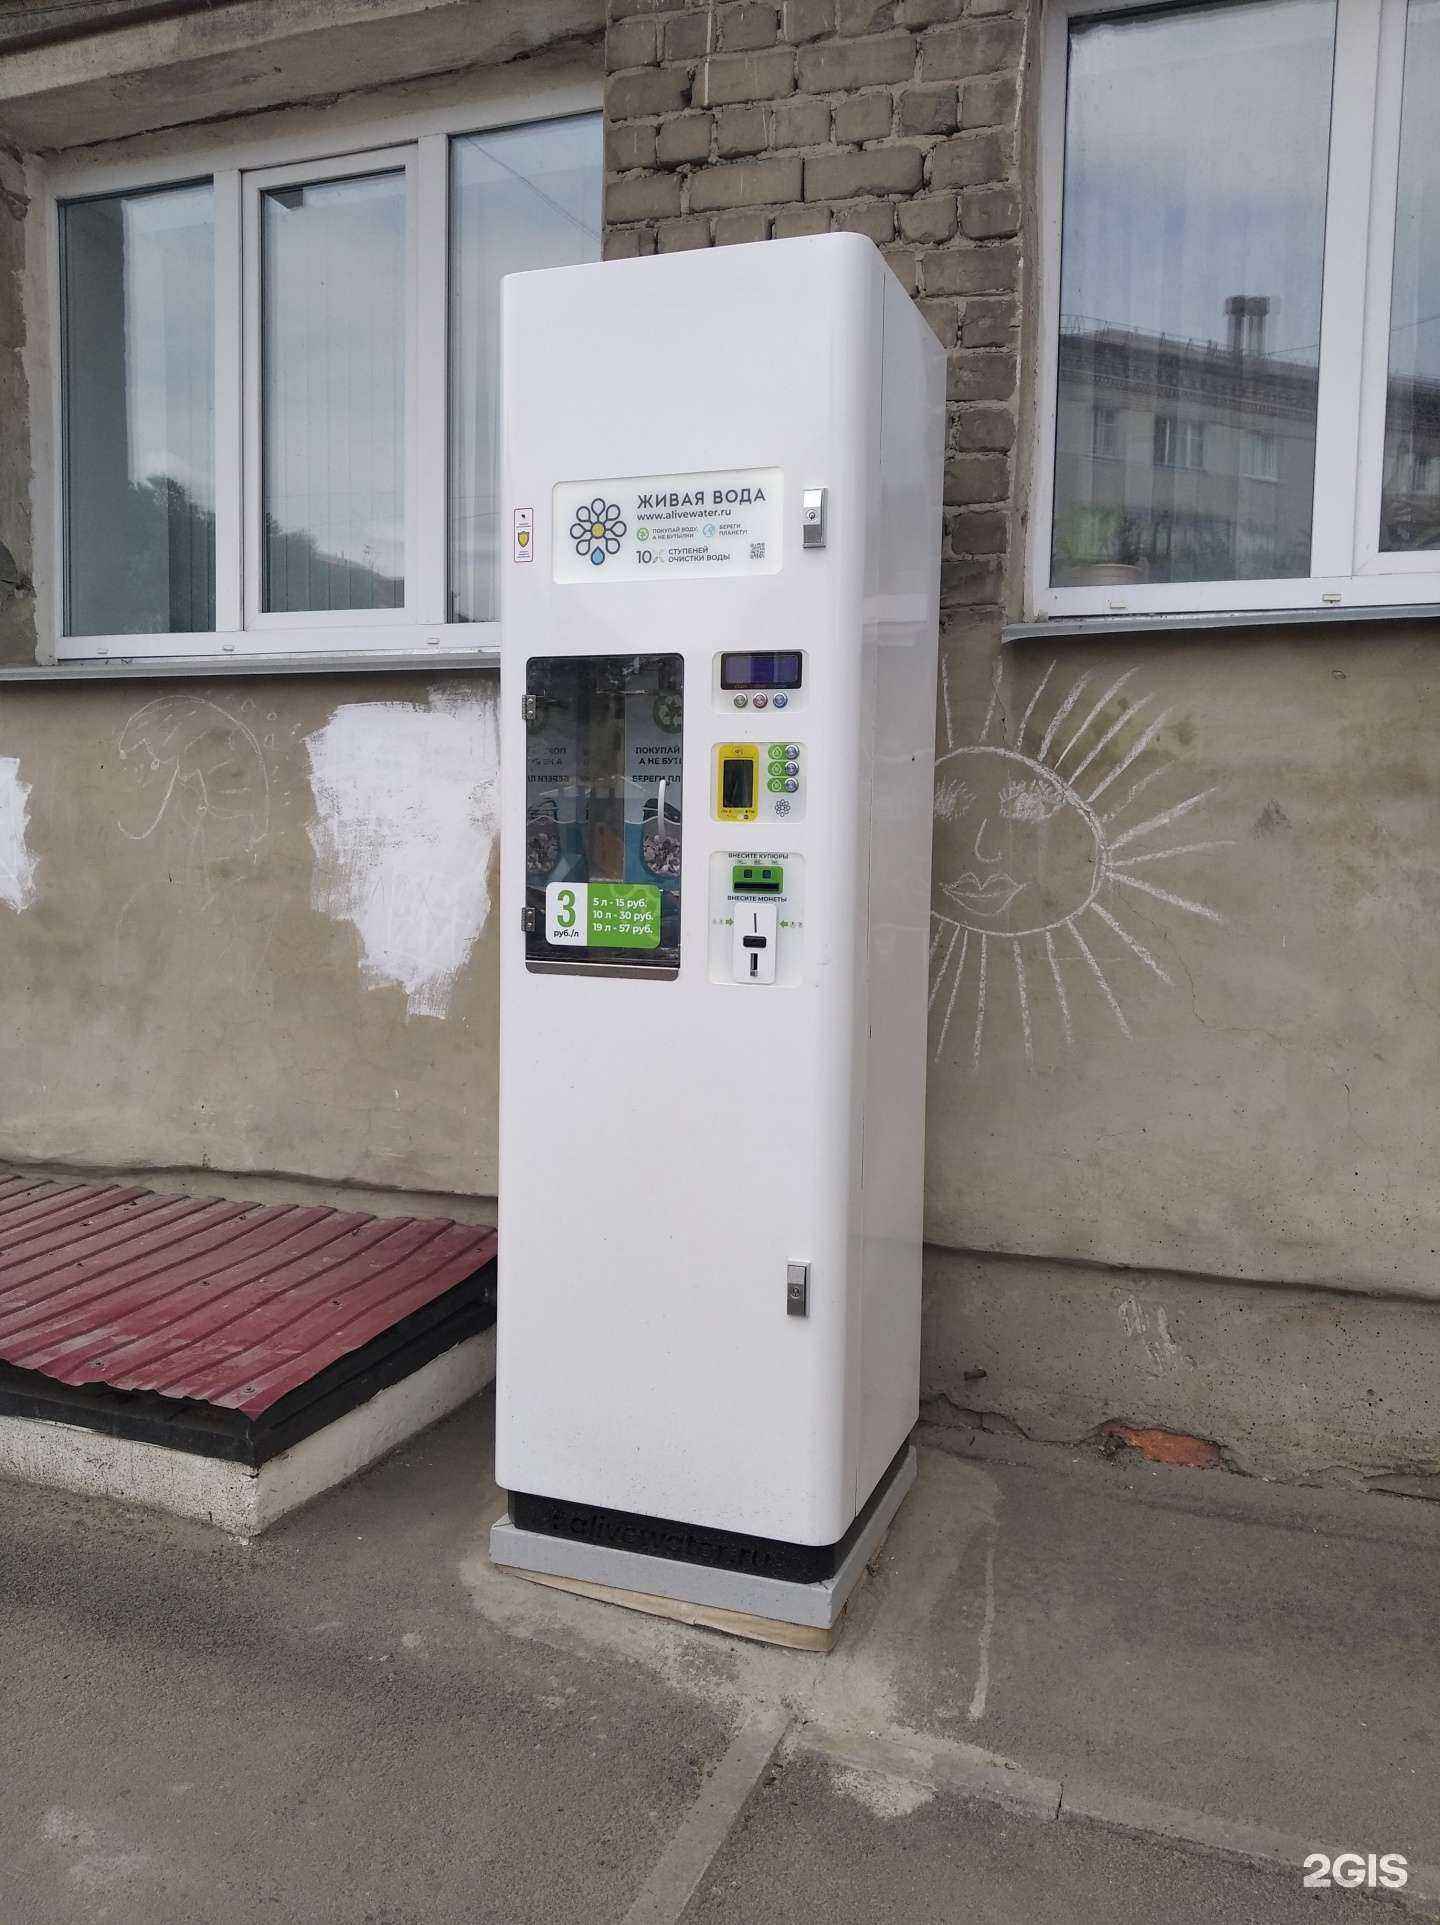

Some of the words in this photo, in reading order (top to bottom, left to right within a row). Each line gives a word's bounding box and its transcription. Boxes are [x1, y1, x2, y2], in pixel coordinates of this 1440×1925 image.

[637, 491, 704, 509] ЖИВАЯ
[713, 488, 766, 505] ВОДА
[637, 508, 732, 520] www.alivewater.ru
[636, 550, 652, 564] 10
[668, 546, 709, 556] СТУПЕНЕЙ
[668, 555, 705, 563] ОЧИСТКИ
[706, 553, 730, 562] ВОДЫ
[636, 746, 680, 754] ПОКУПАЙ
[557, 889, 576, 928] 3
[616, 899, 625, 907] 15
[627, 898, 648, 909] руб.
[593, 910, 603, 919] 10
[620, 911, 632, 920] 30
[634, 911, 654, 922] руб.
[553, 929, 579, 938] руб./л
[593, 923, 603, 932] 19
[619, 924, 631, 933] 57
[633, 924, 653, 935] руб.
